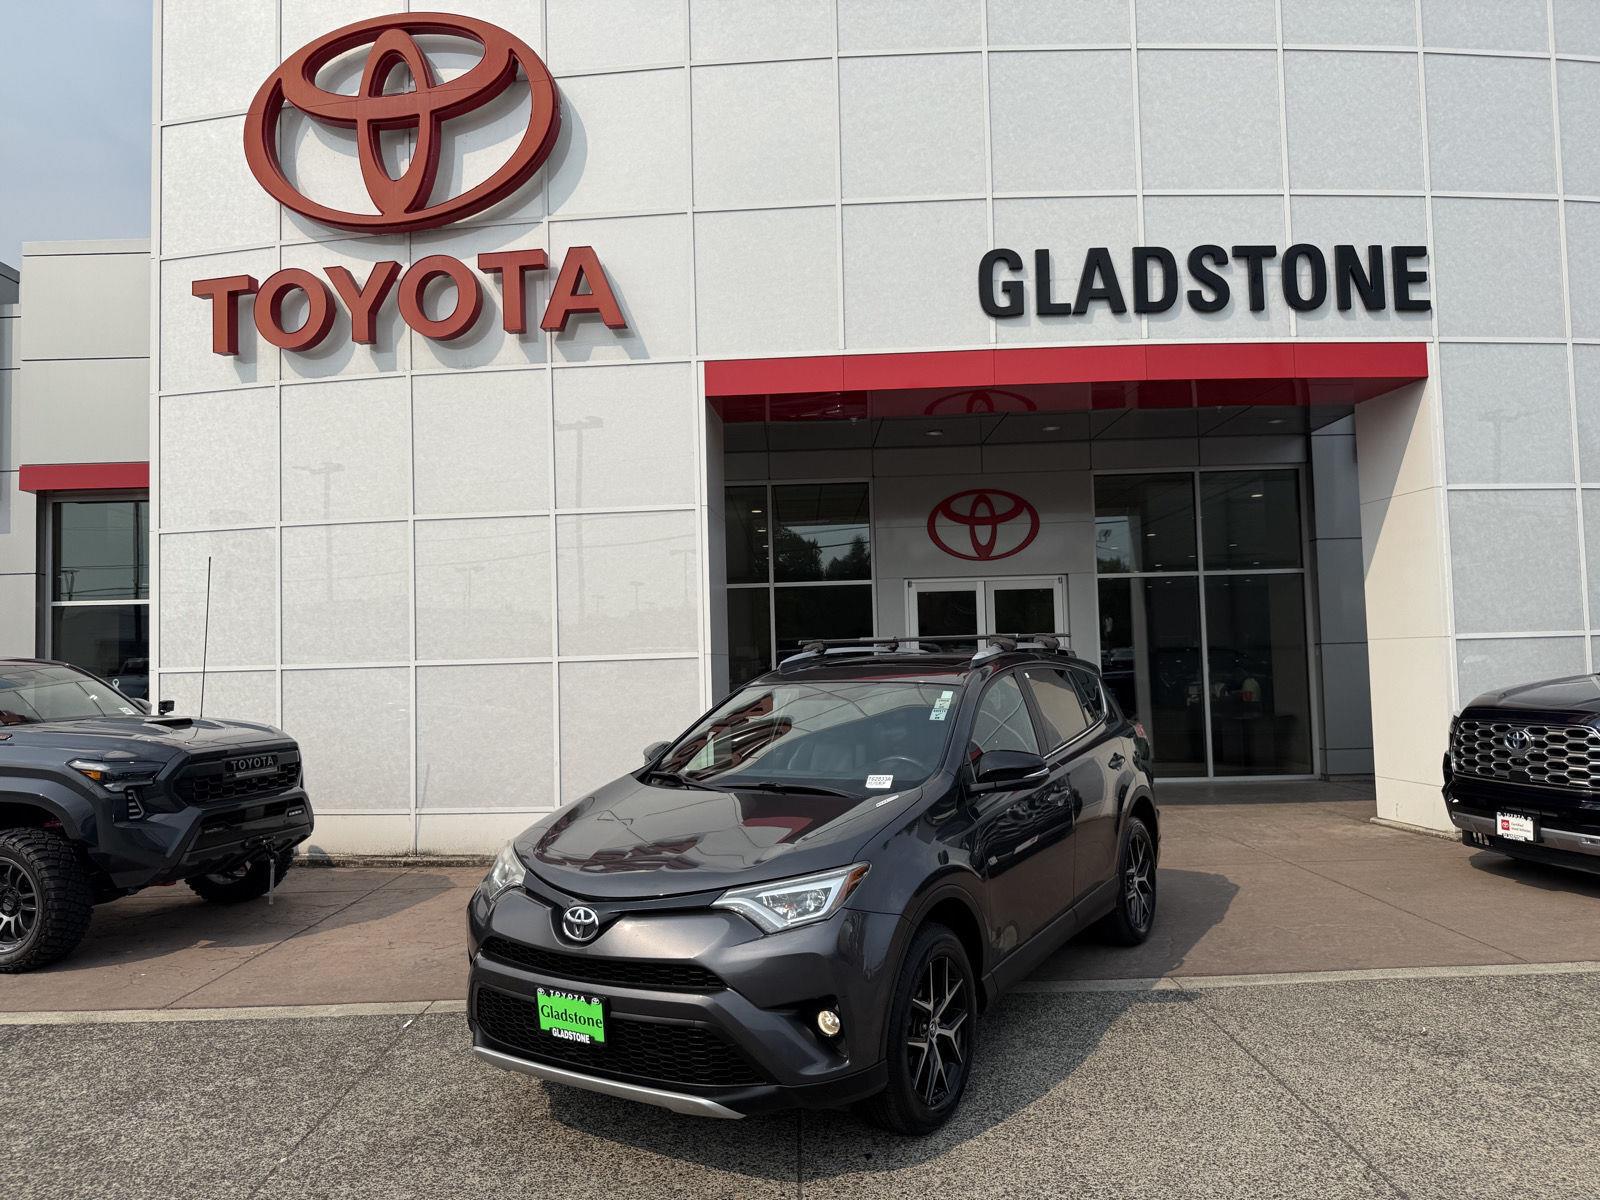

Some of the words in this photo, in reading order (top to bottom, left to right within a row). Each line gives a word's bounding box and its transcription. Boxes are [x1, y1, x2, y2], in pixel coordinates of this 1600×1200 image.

[978, 243, 1432, 318] GLADSTONE
[192, 246, 627, 356] TOYOTA
[231, 756, 274, 771] TOYOTA
[549, 989, 586, 1003] TOYOTA
[541, 1004, 603, 1029] Gladstone
[552, 1027, 591, 1044] GLADSTONE
